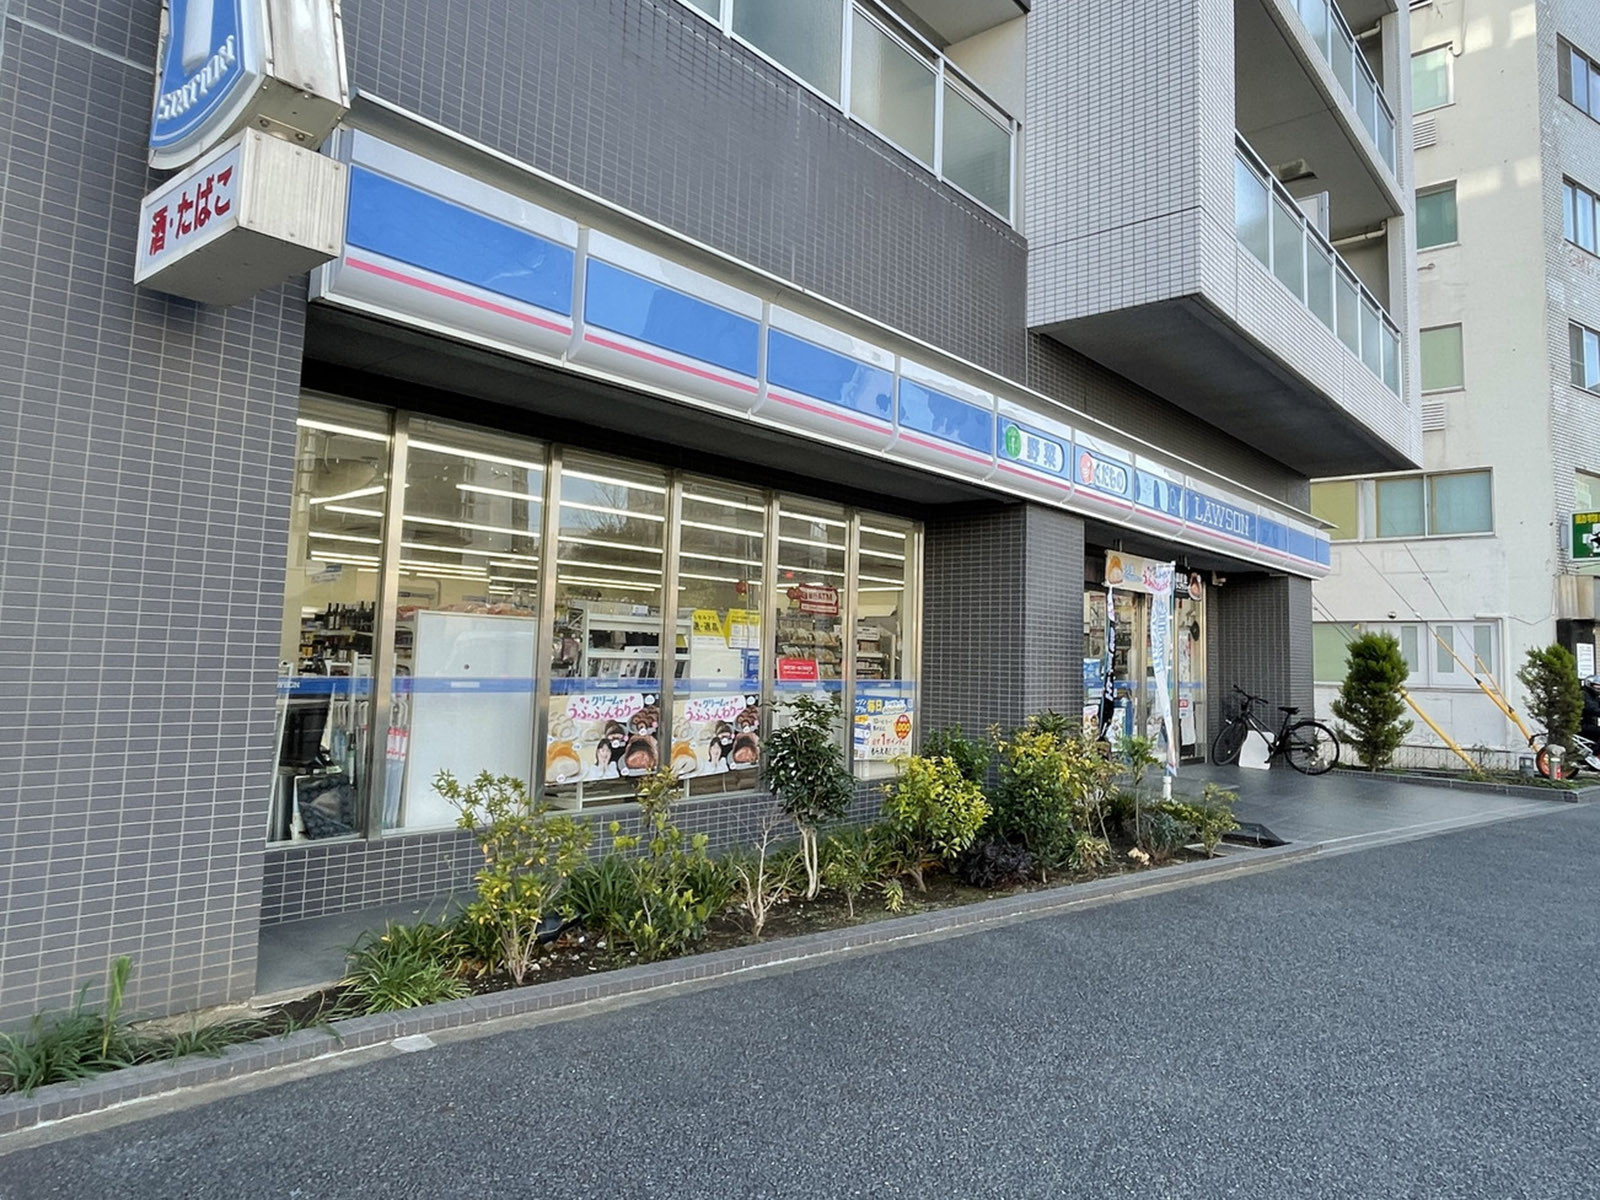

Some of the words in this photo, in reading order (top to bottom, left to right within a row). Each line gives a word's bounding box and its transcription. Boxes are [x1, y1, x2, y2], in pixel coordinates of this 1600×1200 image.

[157, 34, 236, 119] STATION
[149, 165, 233, 256] 酒・たばこ
[1026, 435, 1058, 469] 野菜
[1095, 462, 1125, 492] くだもの
[1194, 496, 1250, 537] LAWSON
